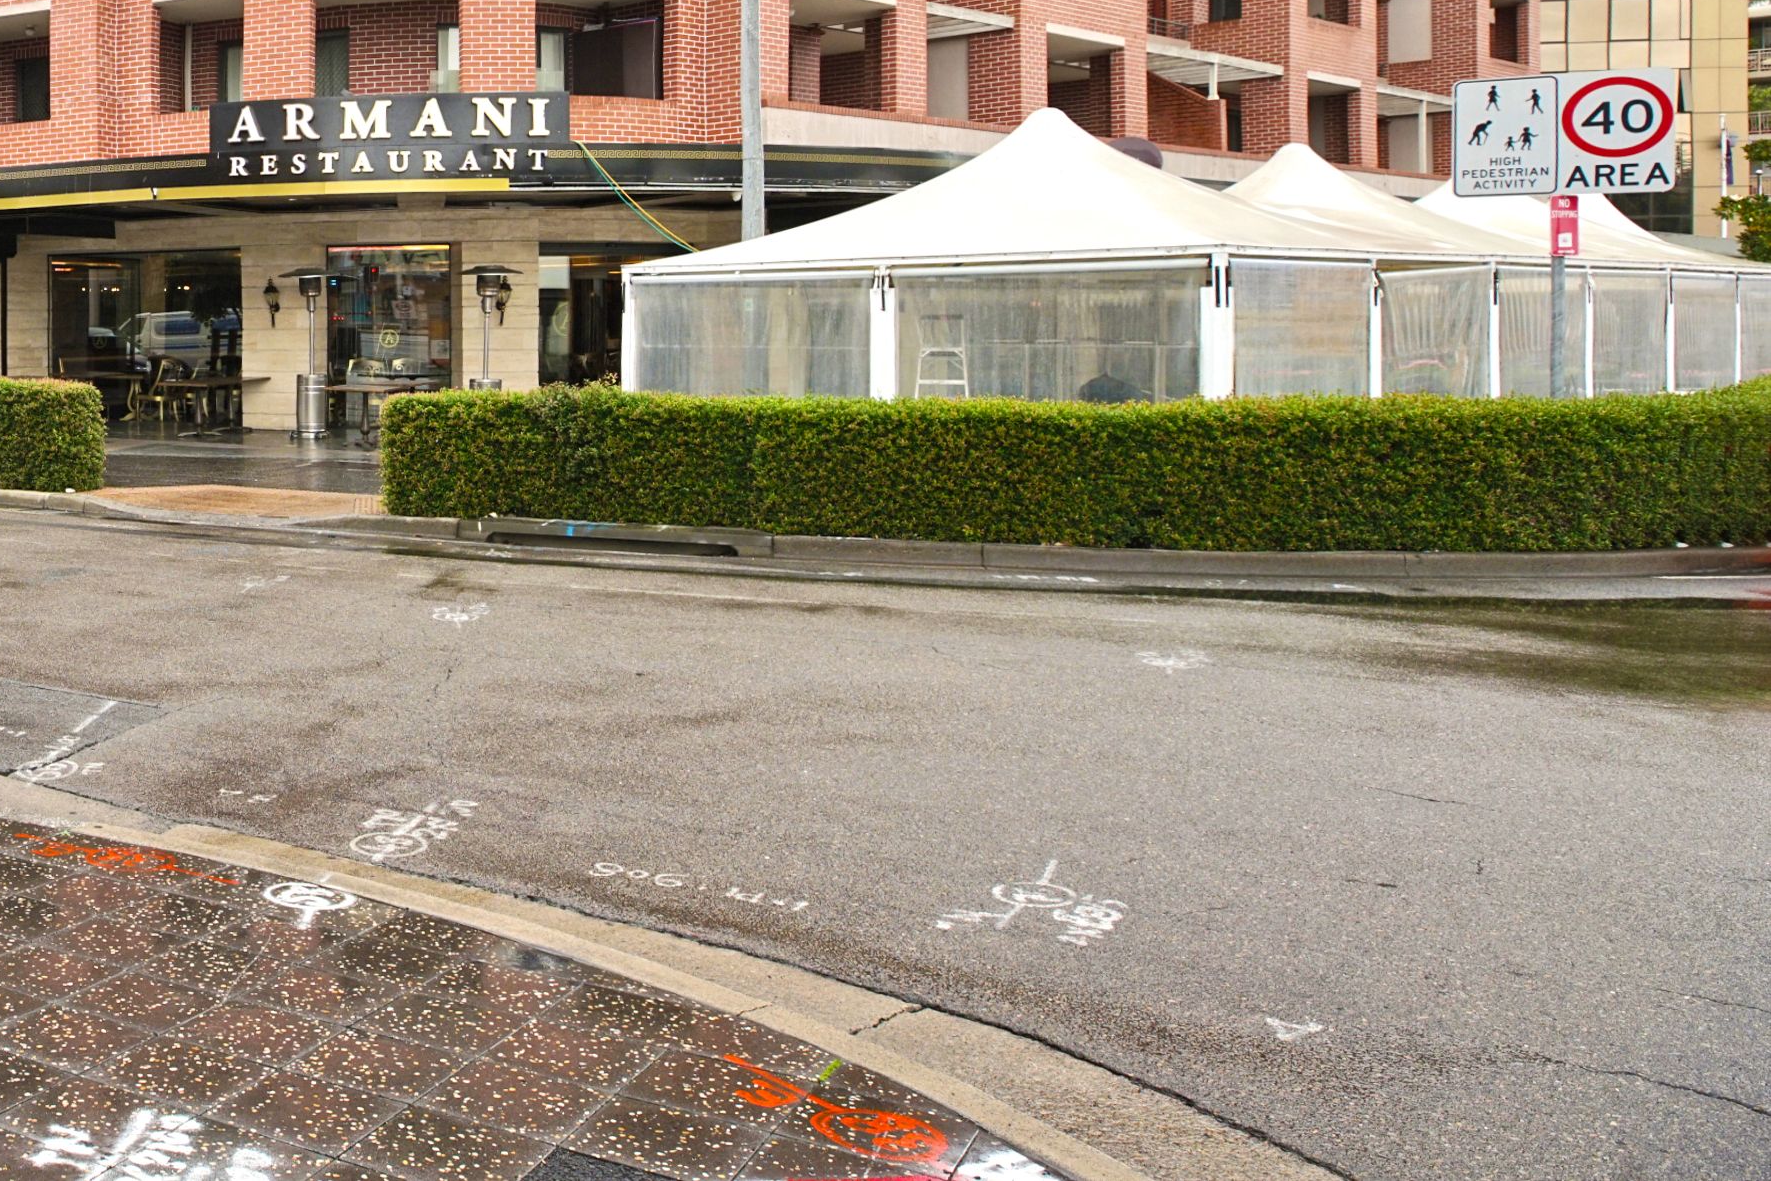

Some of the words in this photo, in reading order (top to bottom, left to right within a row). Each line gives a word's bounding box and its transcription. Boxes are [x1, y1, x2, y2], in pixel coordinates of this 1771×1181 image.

[228, 97, 550, 143] ARMANI
[1581, 99, 1654, 135] 40
[229, 148, 548, 176] RESTAURANT
[1489, 156, 1522, 166] HIGH
[1462, 167, 1550, 179] PEDESTRIAN
[1565, 162, 1670, 188] AREA
[1473, 179, 1538, 190] ACTIVITY
[1558, 198, 1571, 208] NO
